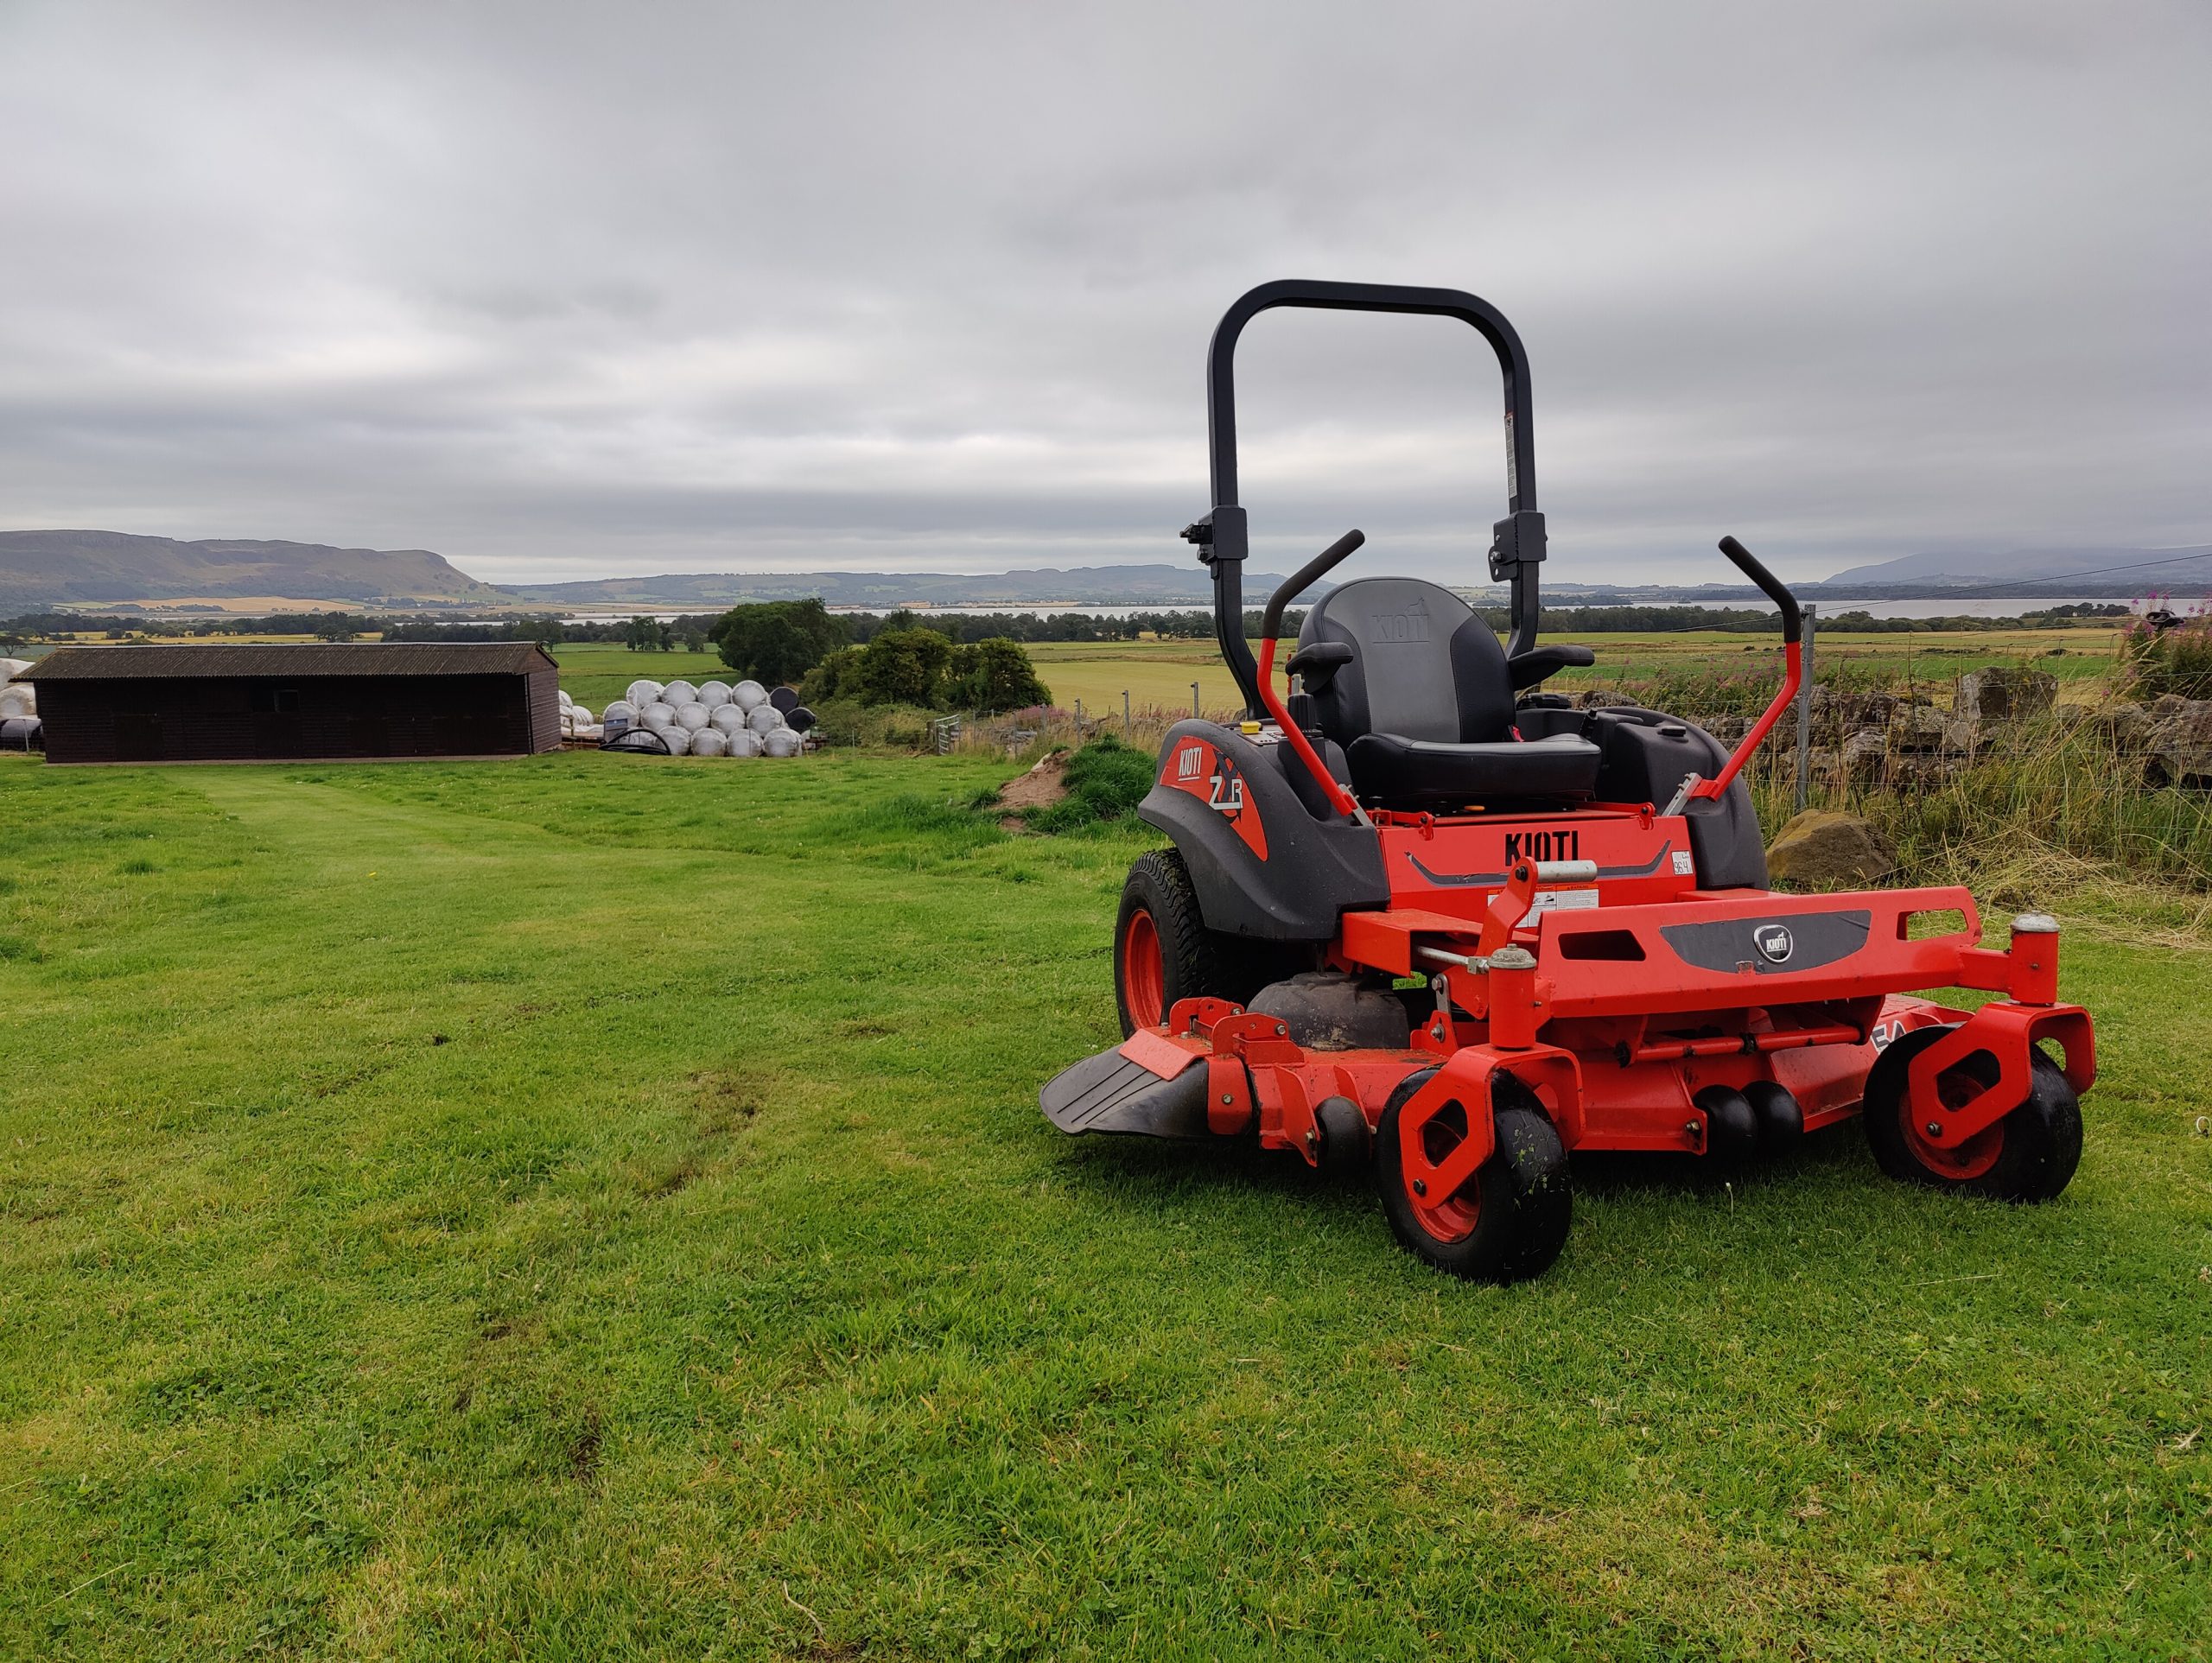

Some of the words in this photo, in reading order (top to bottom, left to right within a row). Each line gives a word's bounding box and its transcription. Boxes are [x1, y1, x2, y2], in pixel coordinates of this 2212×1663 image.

[1371, 614, 1429, 641] KIOTI
[1179, 746, 1203, 777] KIOTI
[1505, 830, 1579, 867] KIOTI
[1766, 937, 1788, 950] KIOTI
